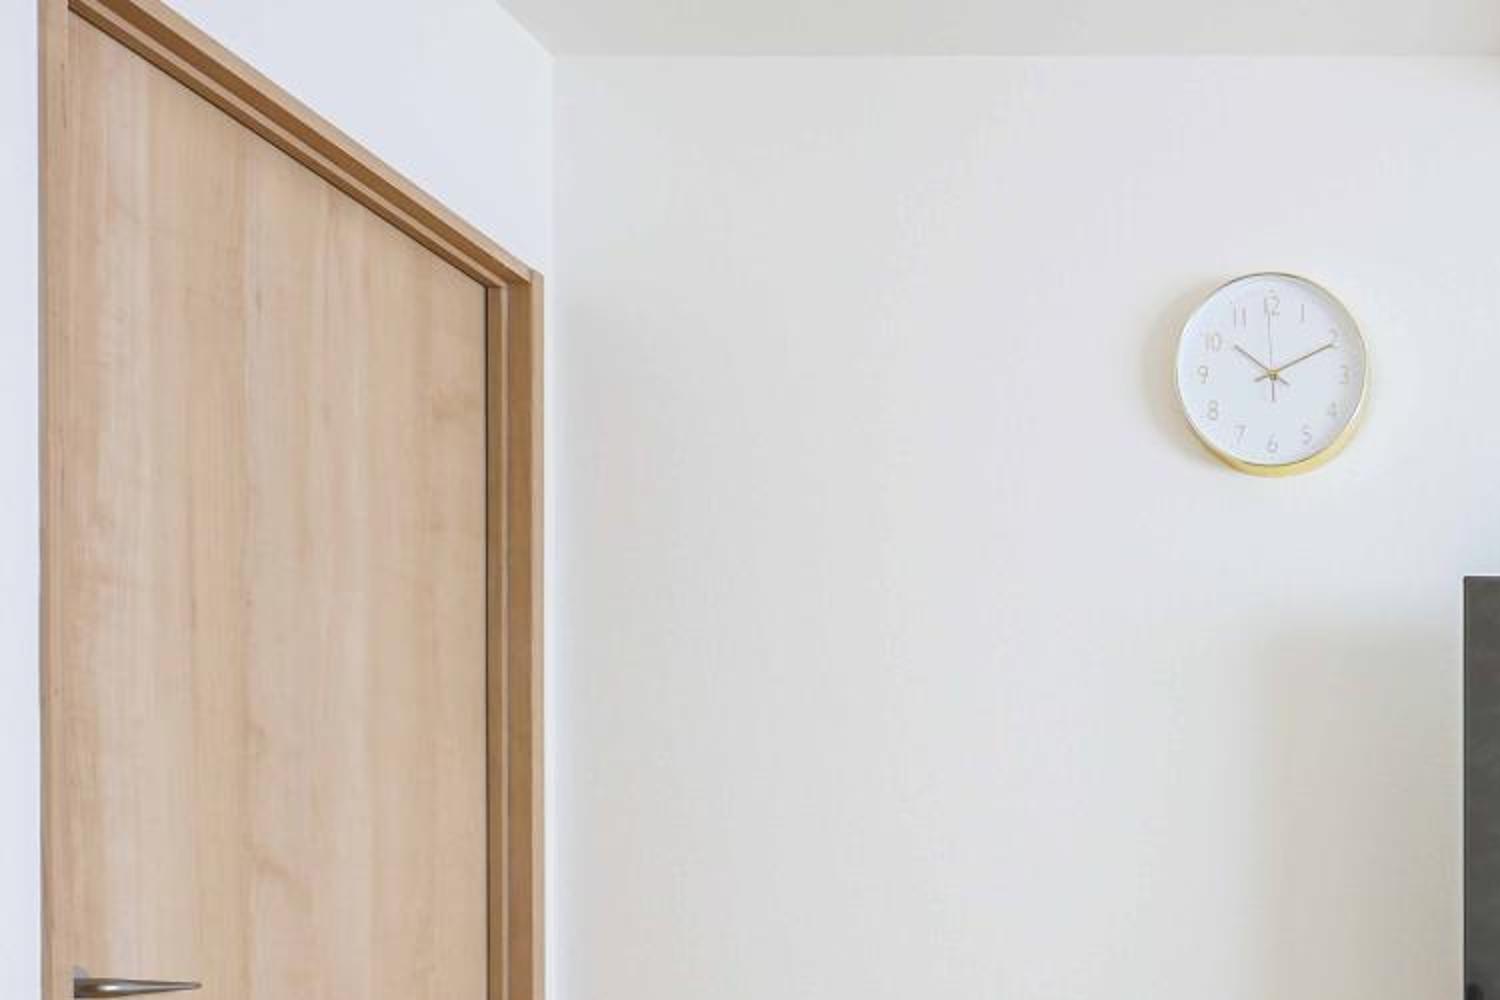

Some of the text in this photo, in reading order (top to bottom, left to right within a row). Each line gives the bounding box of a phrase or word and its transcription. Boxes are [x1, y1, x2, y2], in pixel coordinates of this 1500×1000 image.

[1264, 296, 1280, 316] 12
[1233, 305, 1246, 328] 11
[1205, 332, 1222, 352] 10
[1197, 365, 1209, 384] 9
[1207, 400, 1219, 421] 8
[1234, 425, 1246, 444] 7
[1267, 433, 1279, 453] 6
[1301, 425, 1313, 445] 5
